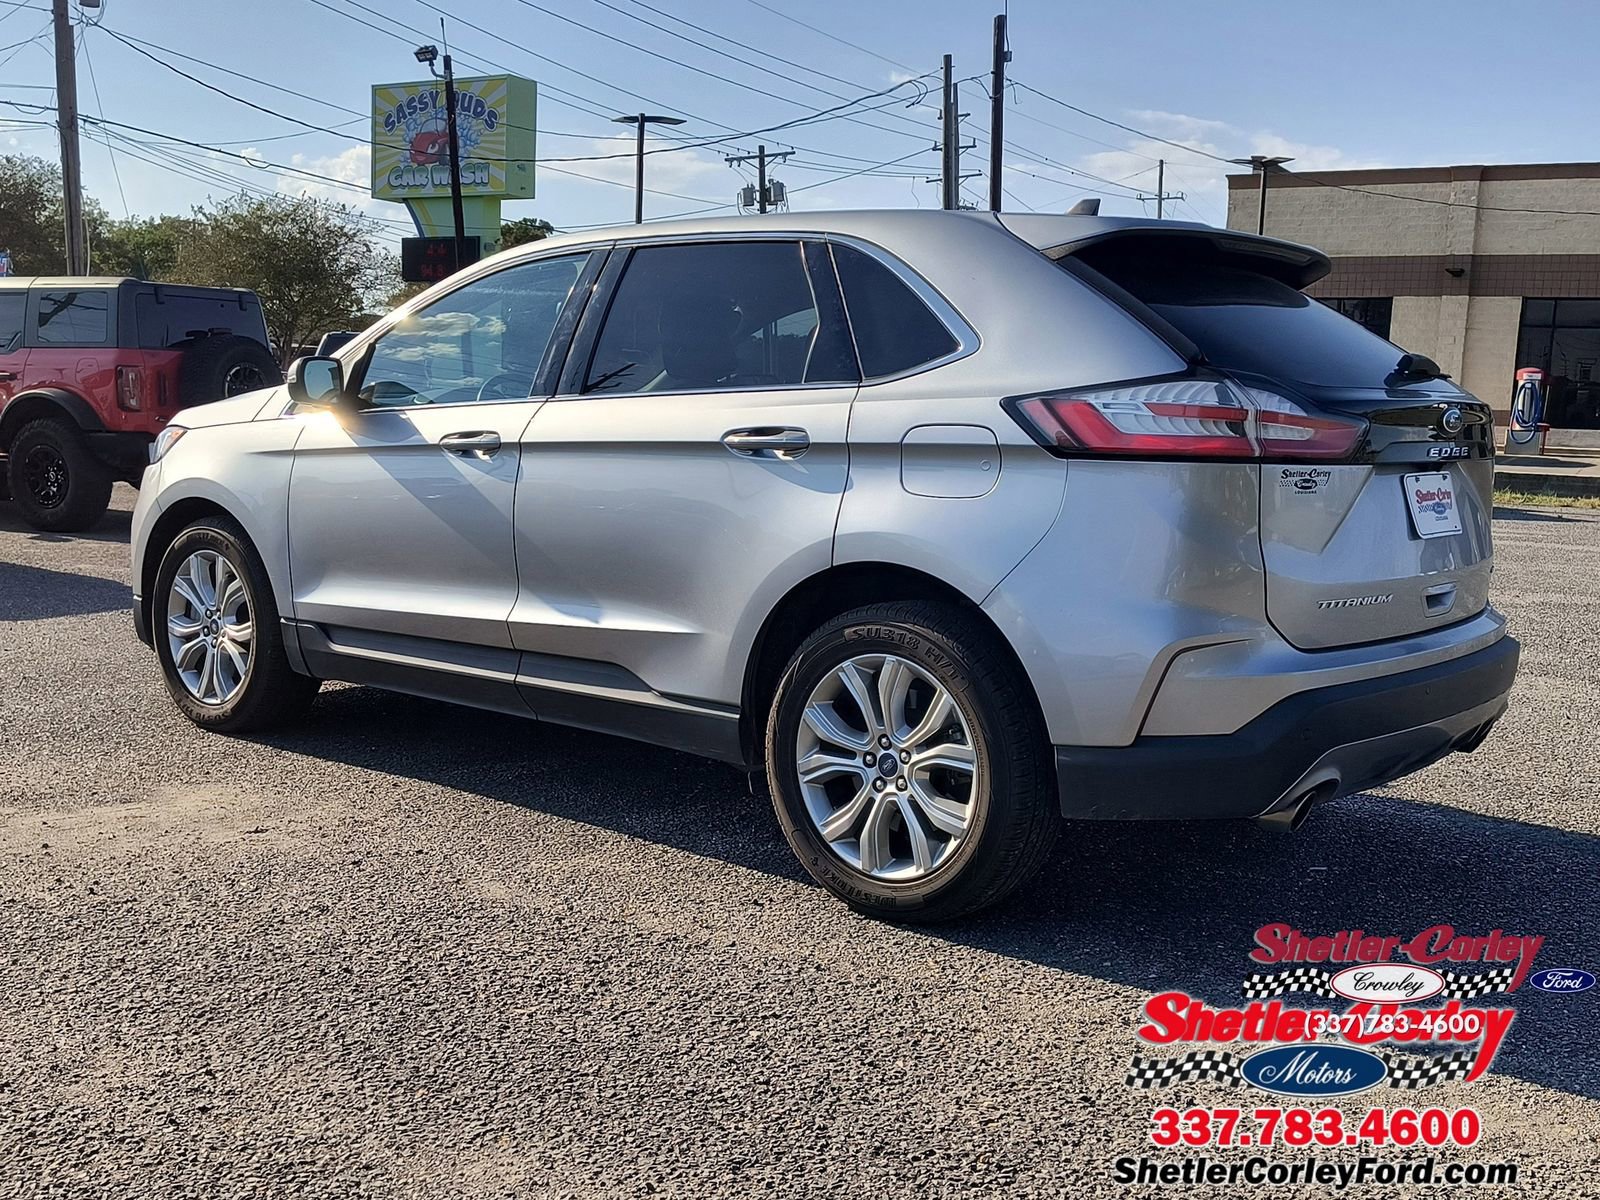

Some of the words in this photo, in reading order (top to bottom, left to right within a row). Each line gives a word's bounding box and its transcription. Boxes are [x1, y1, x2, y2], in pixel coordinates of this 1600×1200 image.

[384, 89, 441, 134] SASSY
[389, 165, 429, 188] CAR
[431, 163, 490, 187] WSH
[1427, 446, 1469, 457] EDGE
[1317, 593, 1394, 609] TITANIUM
[852, 626, 920, 650] SU318
